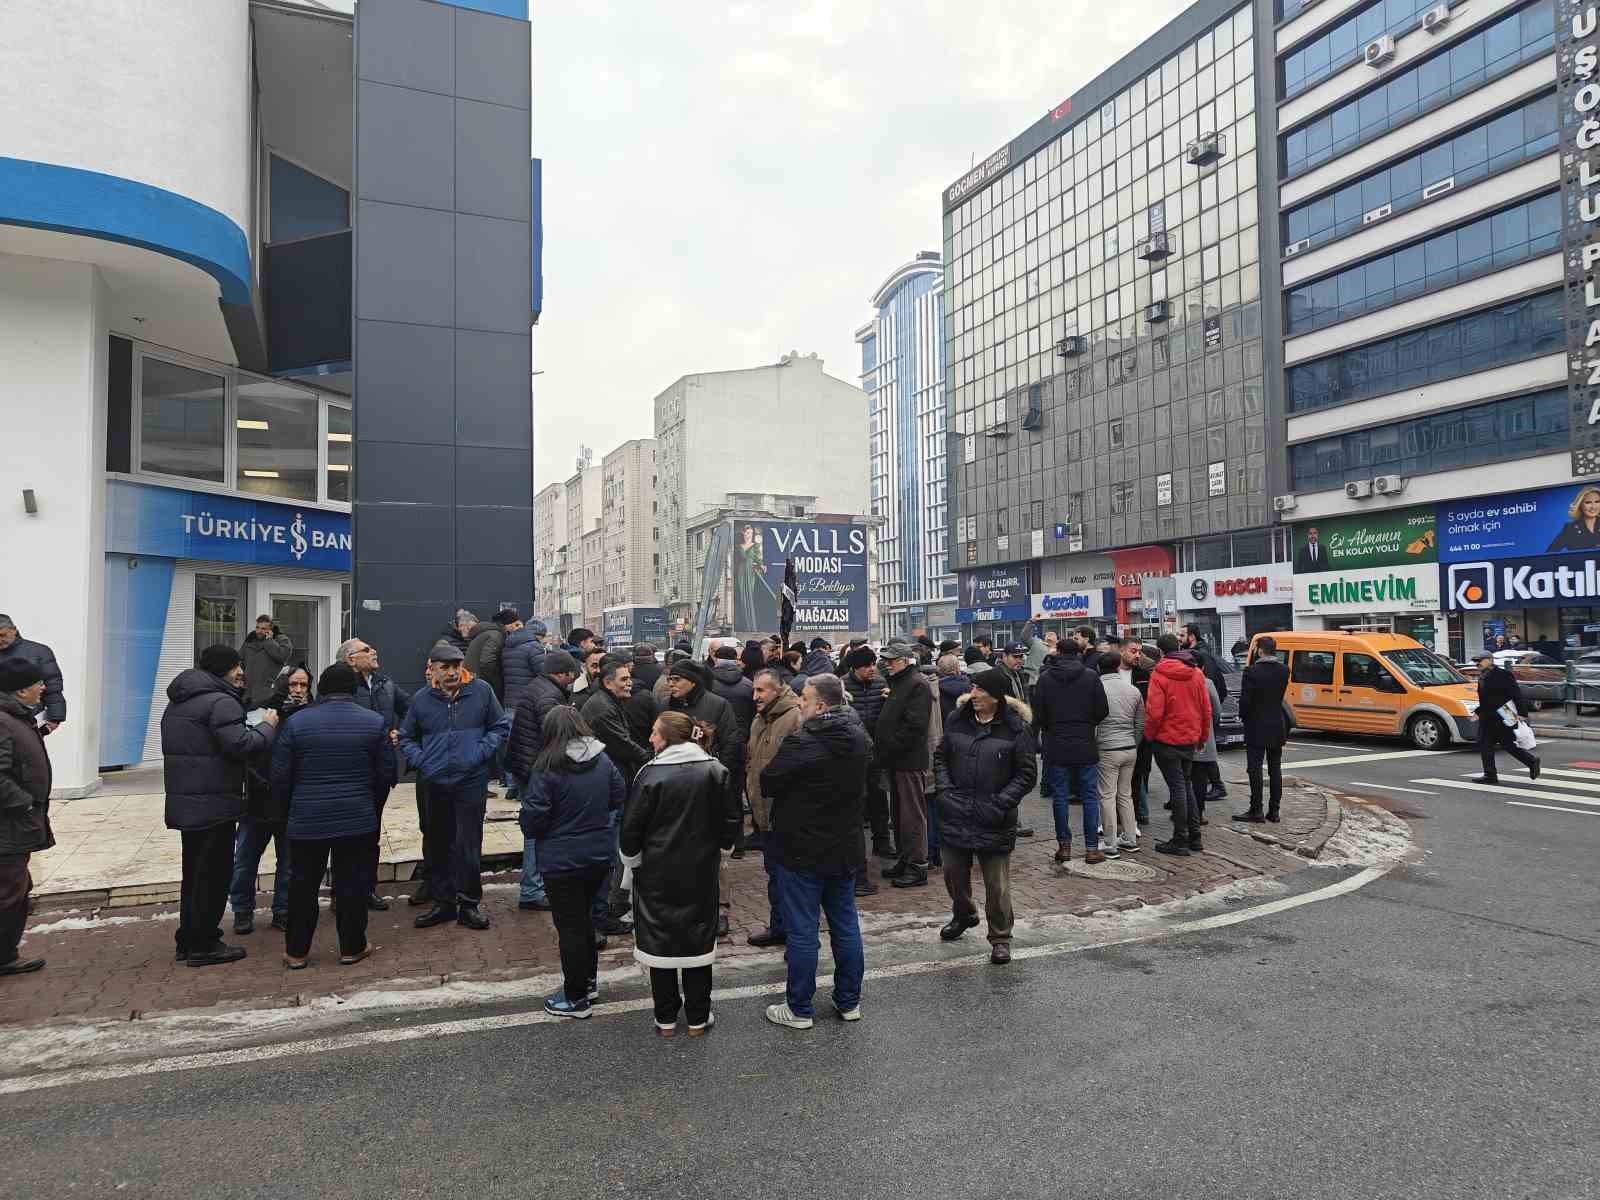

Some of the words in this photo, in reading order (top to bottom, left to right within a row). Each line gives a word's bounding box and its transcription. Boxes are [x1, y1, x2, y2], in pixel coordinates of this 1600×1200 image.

[1572, 0, 1600, 222] UŞOĞLU
[1448, 512, 1454, 522] 5
[1456, 509, 1484, 523] ayda
[1486, 509, 1500, 517] ev
[1502, 502, 1537, 516] sahibi
[181, 512, 286, 544] TÜRKİYE
[1448, 522, 1480, 535] olmak
[770, 527, 865, 555] VALLS
[1345, 547, 1374, 557] KOLAY
[1376, 544, 1399, 553] YOLU
[794, 556, 842, 574] MODASI
[979, 579, 987, 590] EV
[987, 578, 996, 588] DE
[1214, 576, 1267, 596] BOSCH
[1308, 574, 1417, 604] EMİNEVİM
[987, 591, 1001, 600] OTO
[795, 606, 849, 623] MAĞAZASI
